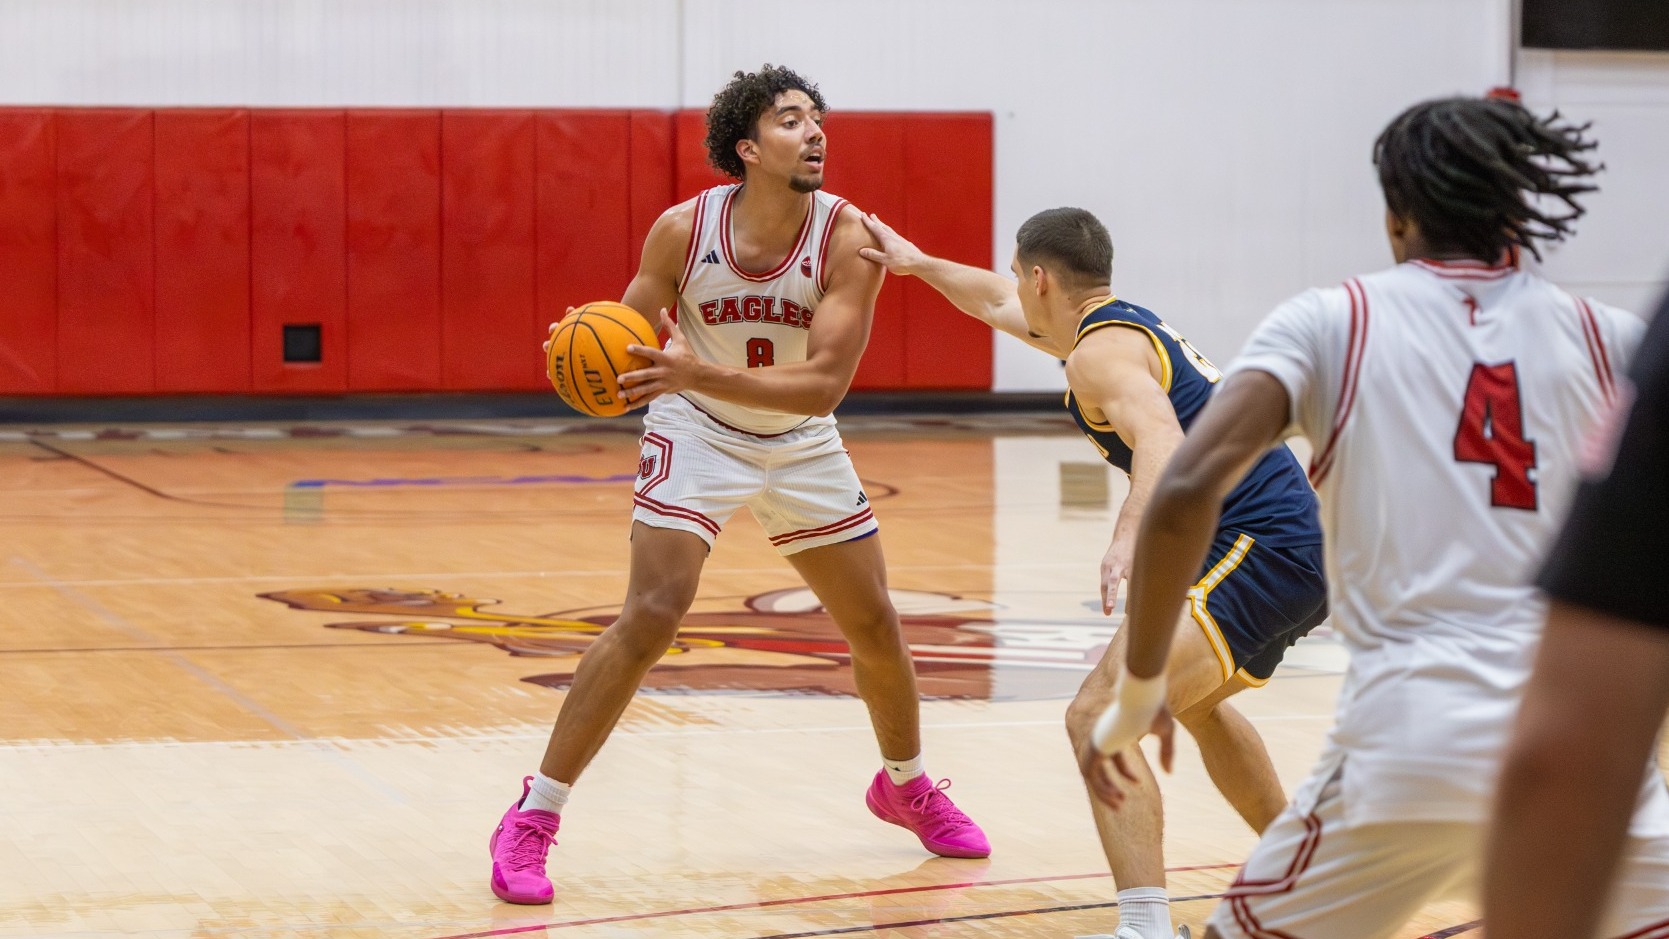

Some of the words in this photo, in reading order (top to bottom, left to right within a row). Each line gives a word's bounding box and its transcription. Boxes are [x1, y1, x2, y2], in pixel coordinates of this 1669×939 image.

[699, 295, 814, 330] EAGLES
[746, 337, 774, 368] 8
[584, 370, 613, 406] EVO
[1453, 360, 1538, 511] 4
